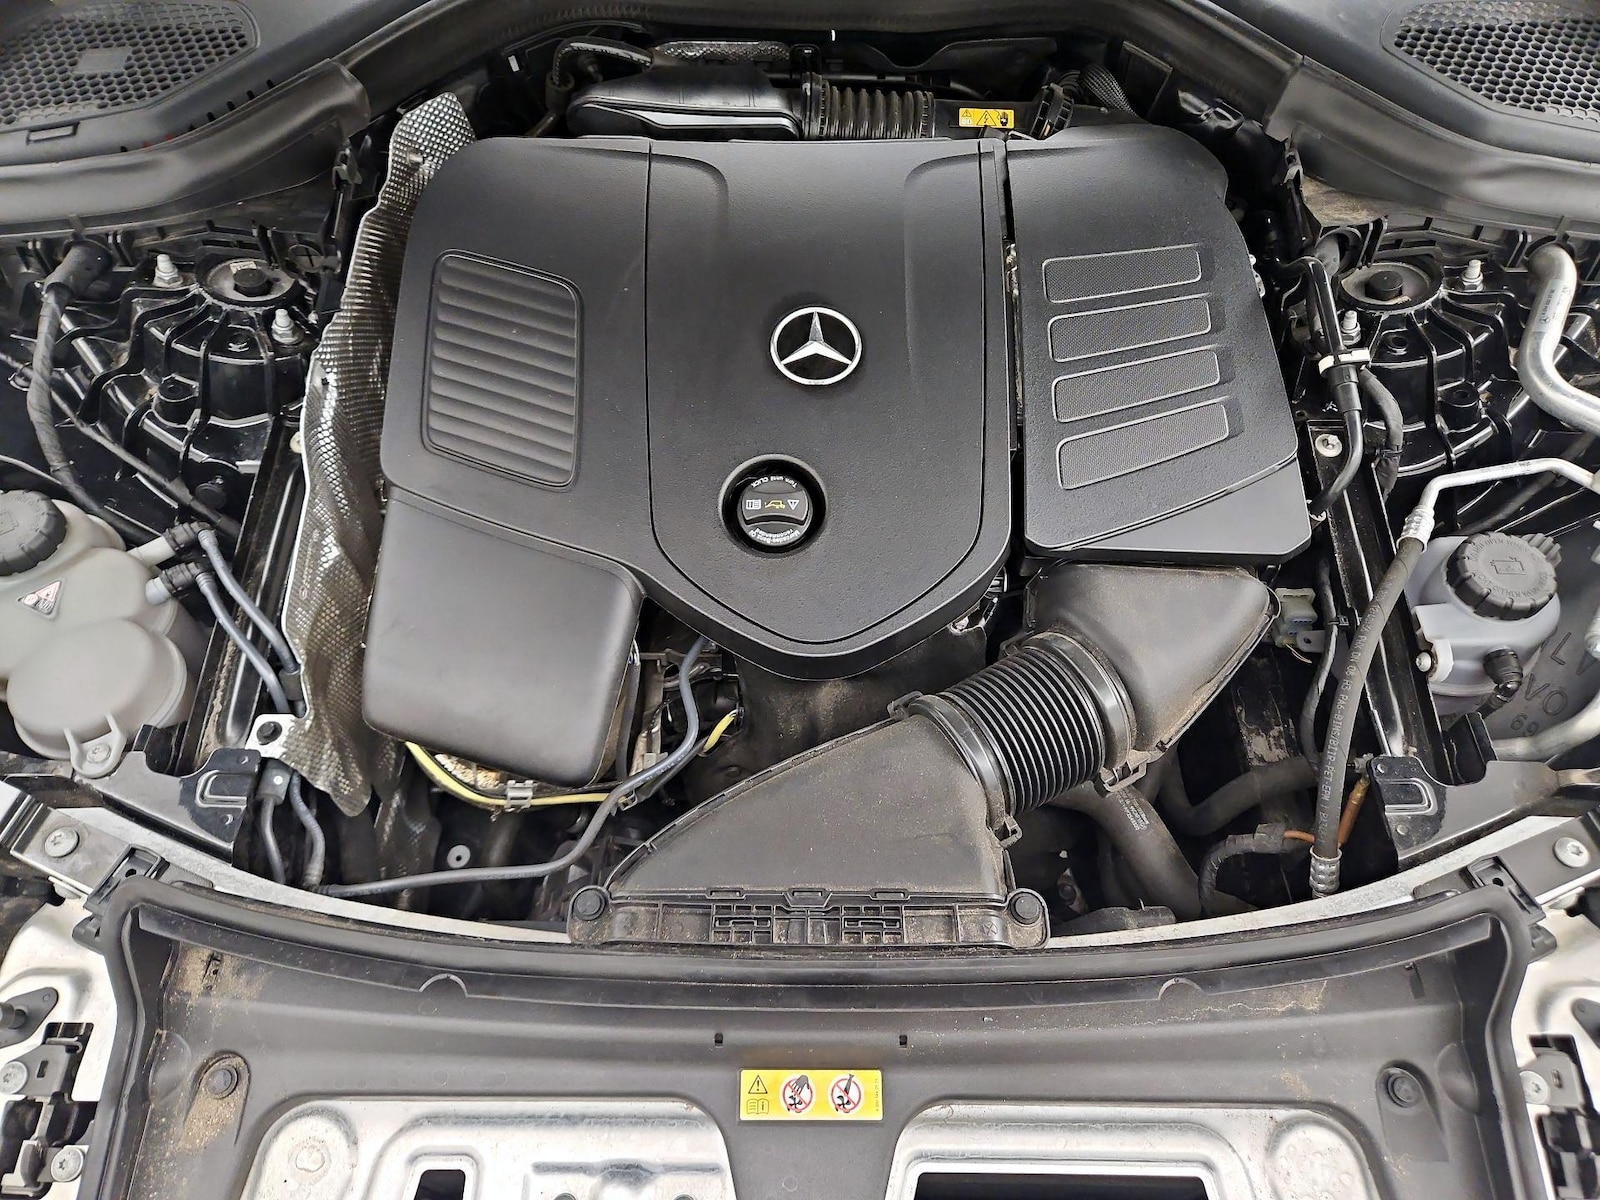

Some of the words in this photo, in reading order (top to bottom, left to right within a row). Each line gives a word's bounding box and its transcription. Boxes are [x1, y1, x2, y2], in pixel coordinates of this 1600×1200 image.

[750, 477, 769, 488] CLICK
[785, 477, 798, 488] Turn
[756, 529, 801, 544] Mercedes-Benz
